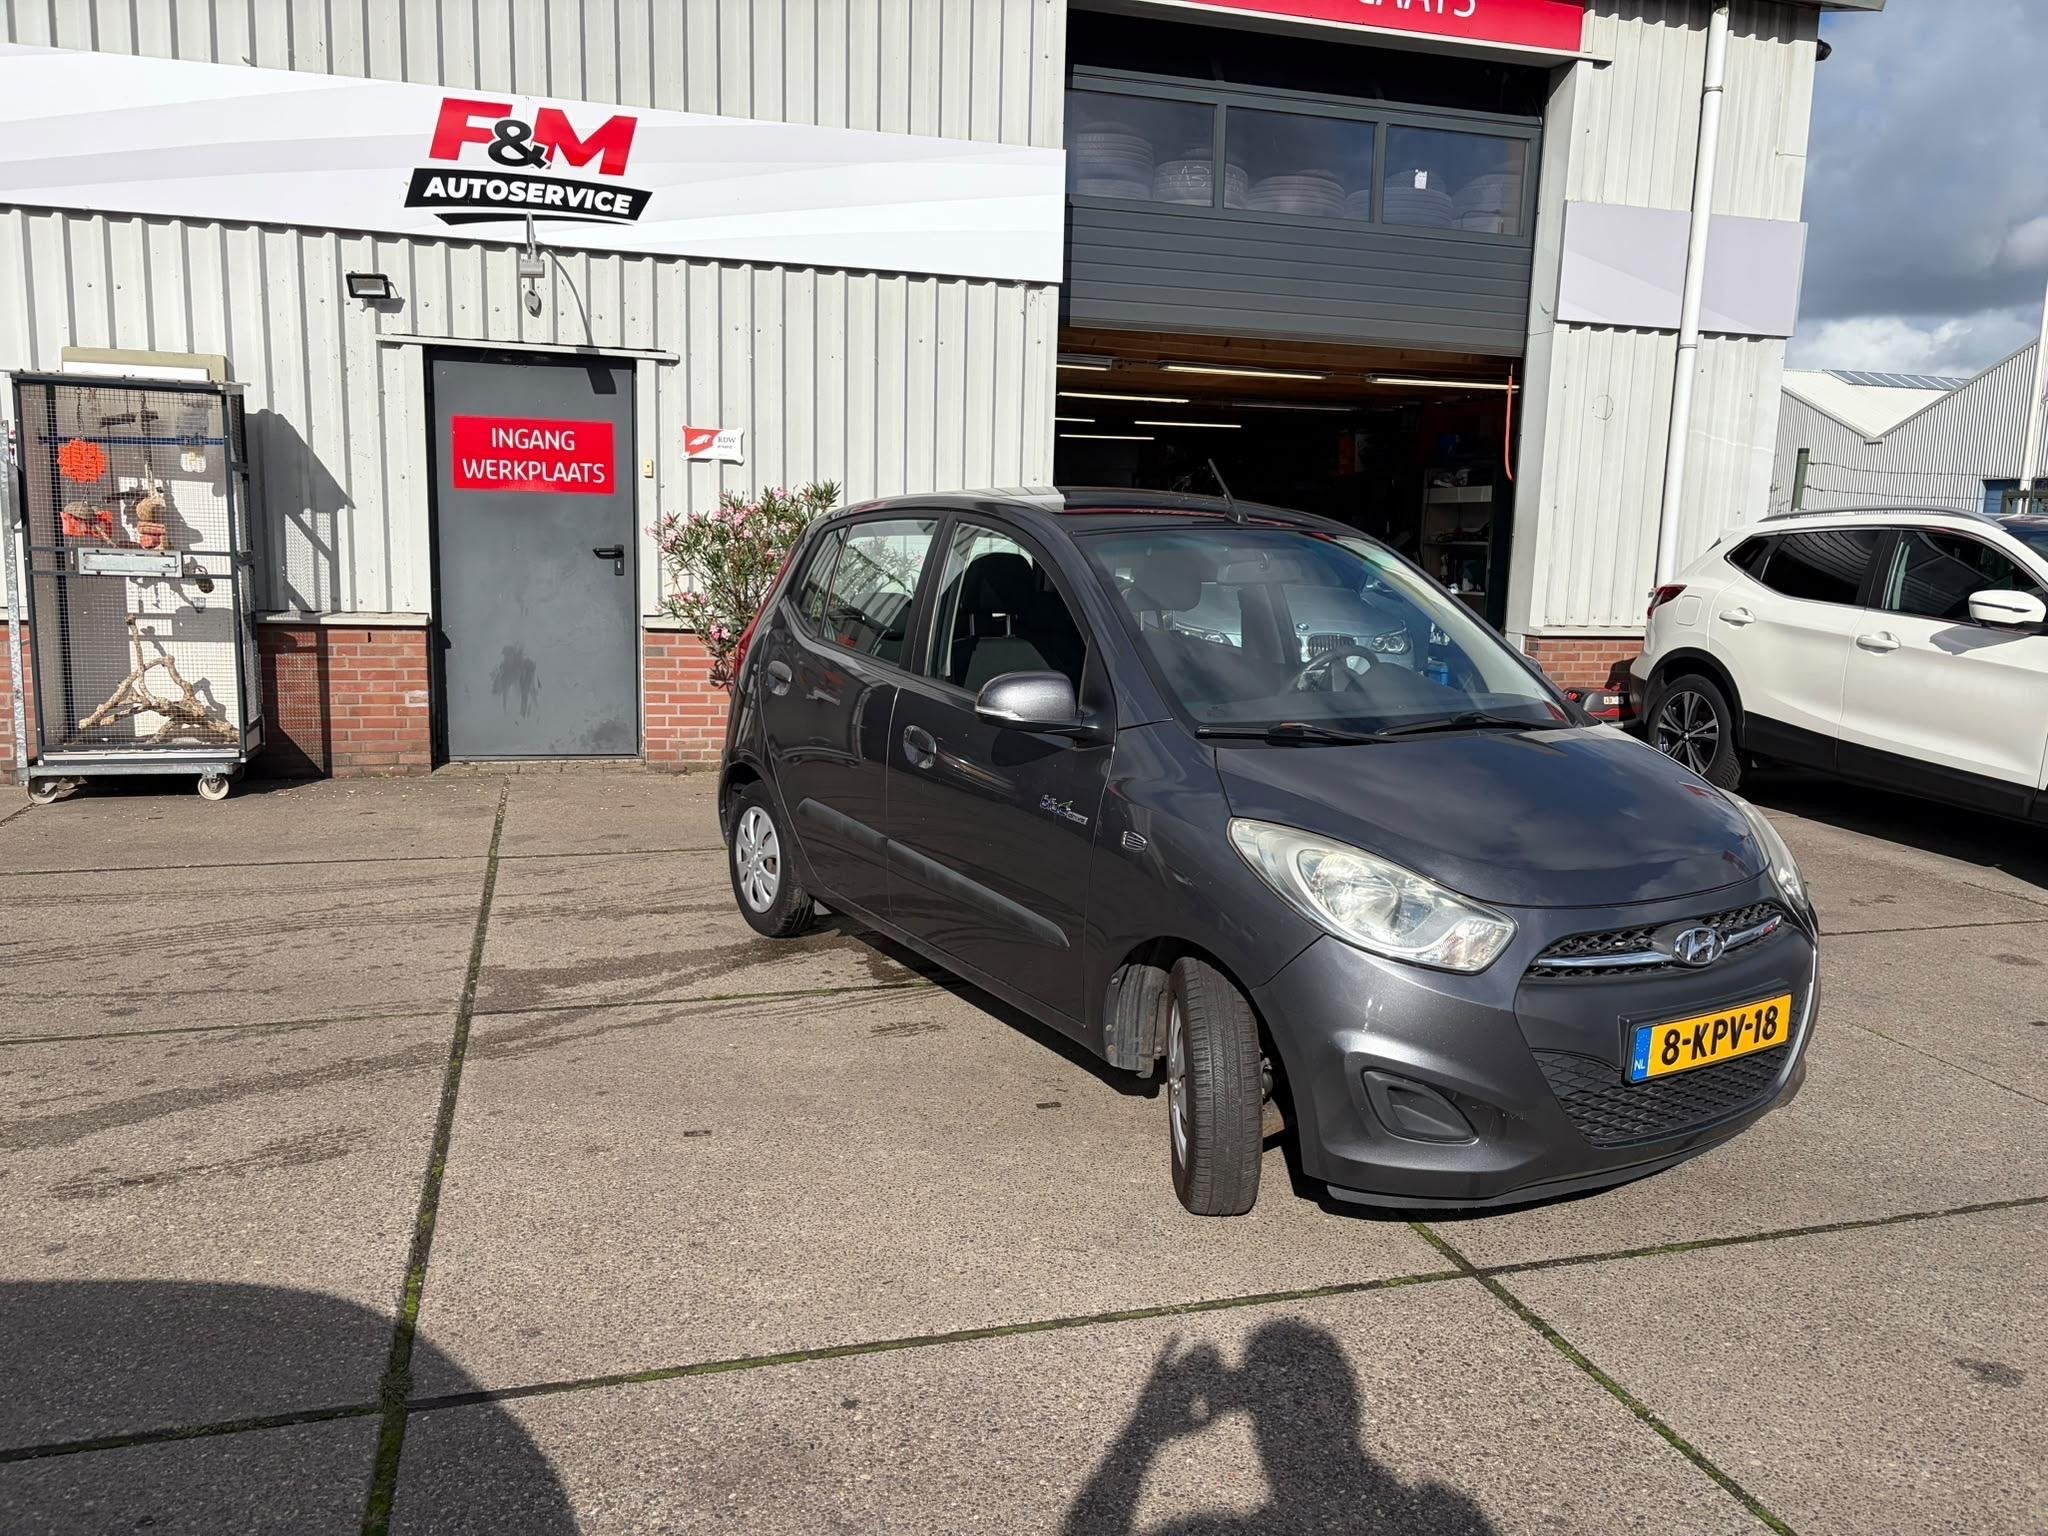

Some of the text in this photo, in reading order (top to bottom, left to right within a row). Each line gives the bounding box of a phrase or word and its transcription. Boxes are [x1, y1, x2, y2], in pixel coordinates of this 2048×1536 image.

[429, 97, 638, 176] F&M
[423, 177, 633, 215] AUTOSERVICE
[491, 427, 575, 451] INGANG
[462, 458, 606, 484] WERKPLAATS
[1661, 1005, 1779, 1066] 8-KPV-18
[1634, 1059, 1646, 1071] NL
